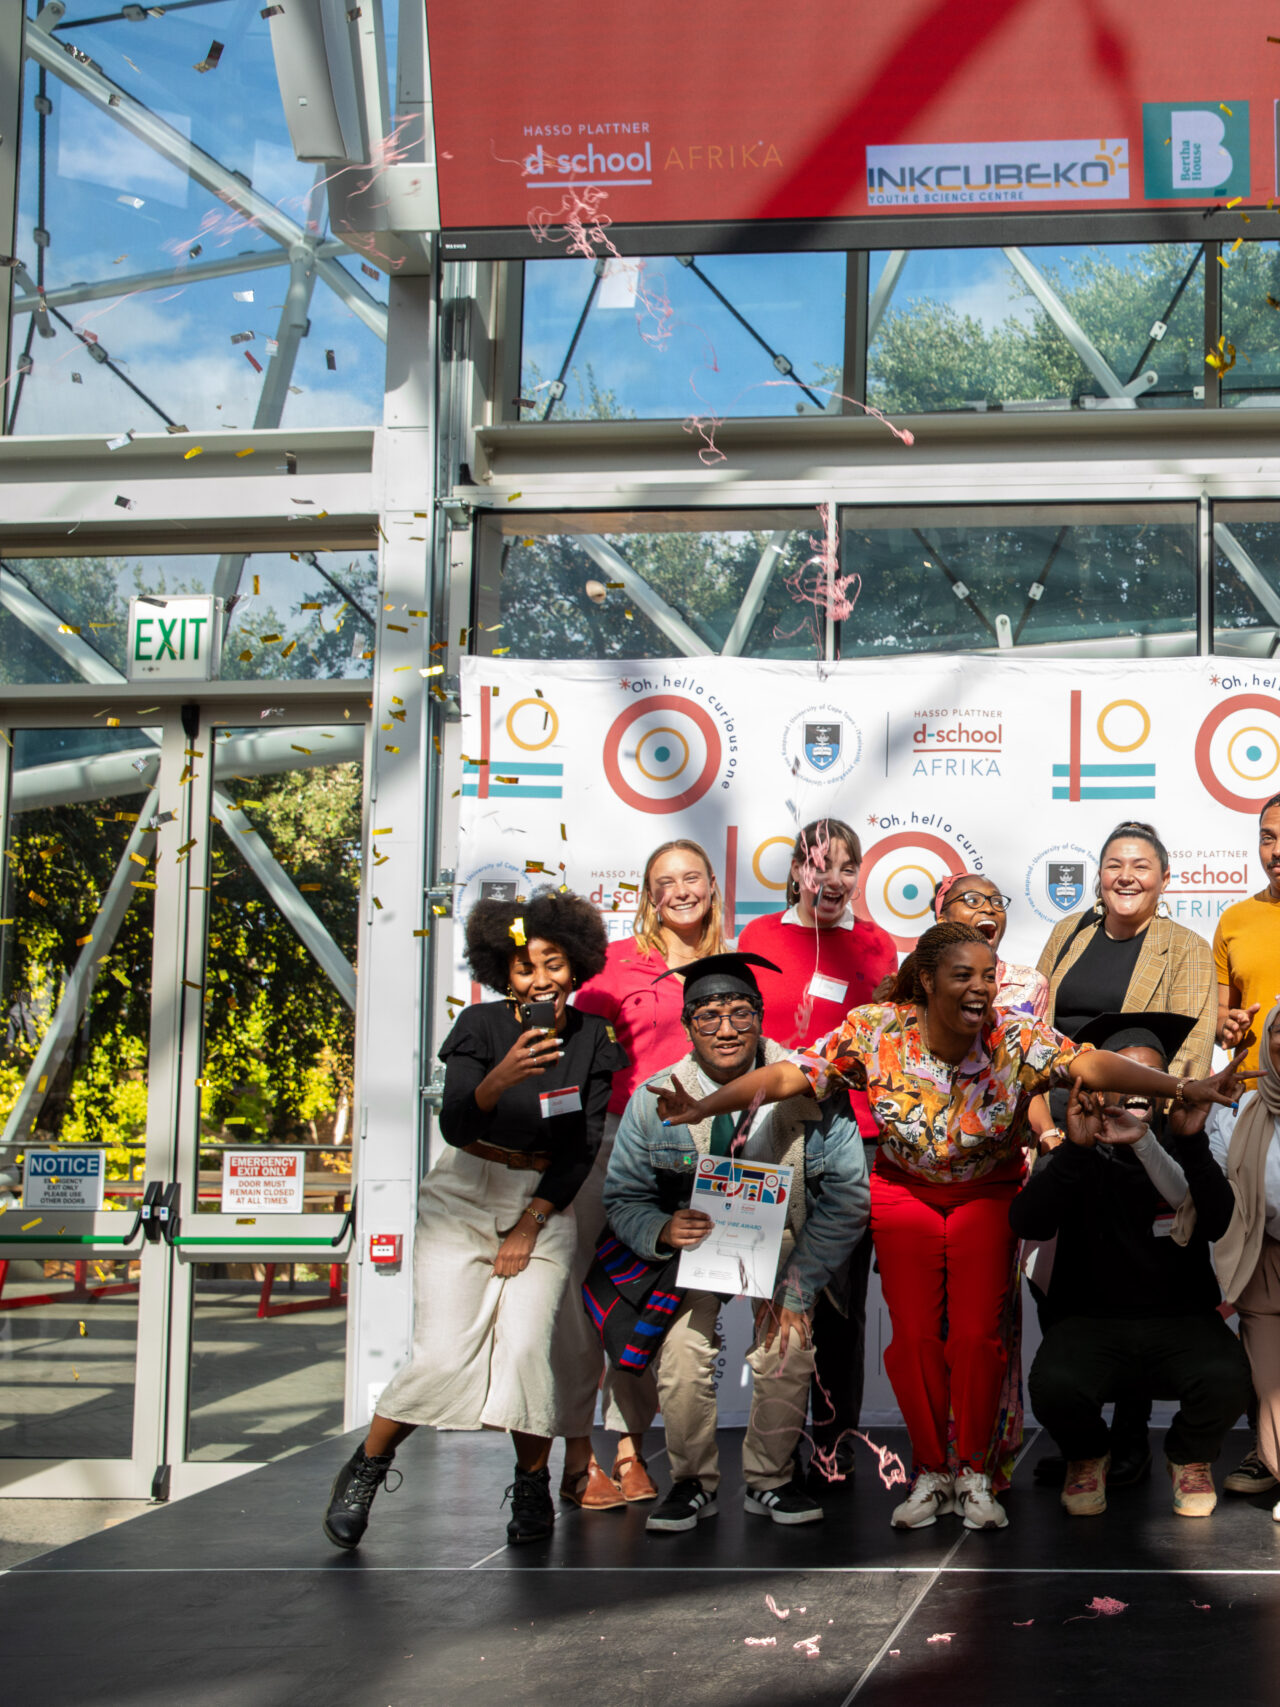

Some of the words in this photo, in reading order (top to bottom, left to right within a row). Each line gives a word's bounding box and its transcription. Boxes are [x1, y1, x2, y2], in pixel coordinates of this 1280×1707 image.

[523, 124, 572, 137] HASSO
[578, 121, 650, 136] PLATTNER
[663, 142, 784, 171] AFRIKA
[1179, 140, 1191, 182] Bertha
[1191, 142, 1203, 182] House
[867, 161, 1109, 194] INKCUBEKO
[869, 194, 909, 205] YOUTH
[924, 191, 975, 203] SCIENCE
[979, 190, 1024, 202] CENTRE
[135, 618, 208, 661] EXIT
[663, 674, 704, 695] hello
[914, 709, 949, 718] HASSO
[952, 708, 1003, 718] PLATTNER
[708, 695, 738, 752] curious
[913, 722, 1002, 744] d-school
[721, 758, 737, 790] one
[912, 757, 1002, 777] AFRIKA
[911, 811, 952, 833] hello
[956, 833, 985, 877] curio
[1166, 850, 1193, 858] ASSO
[1196, 850, 1249, 858] PLATTNER
[591, 870, 626, 878] HASSO
[30, 1157, 99, 1174] NOTICE
[231, 1157, 295, 1167] EMERGENCY
[237, 1166, 260, 1176] EXIT
[261, 1166, 288, 1176] ONLY
[229, 1188, 261, 1196] REMAIN
[263, 1188, 295, 1196] CLOSED
[238, 1180, 261, 1188] DOOR
[263, 1180, 287, 1188] MUST
[263, 1197, 288, 1205] TIMES
